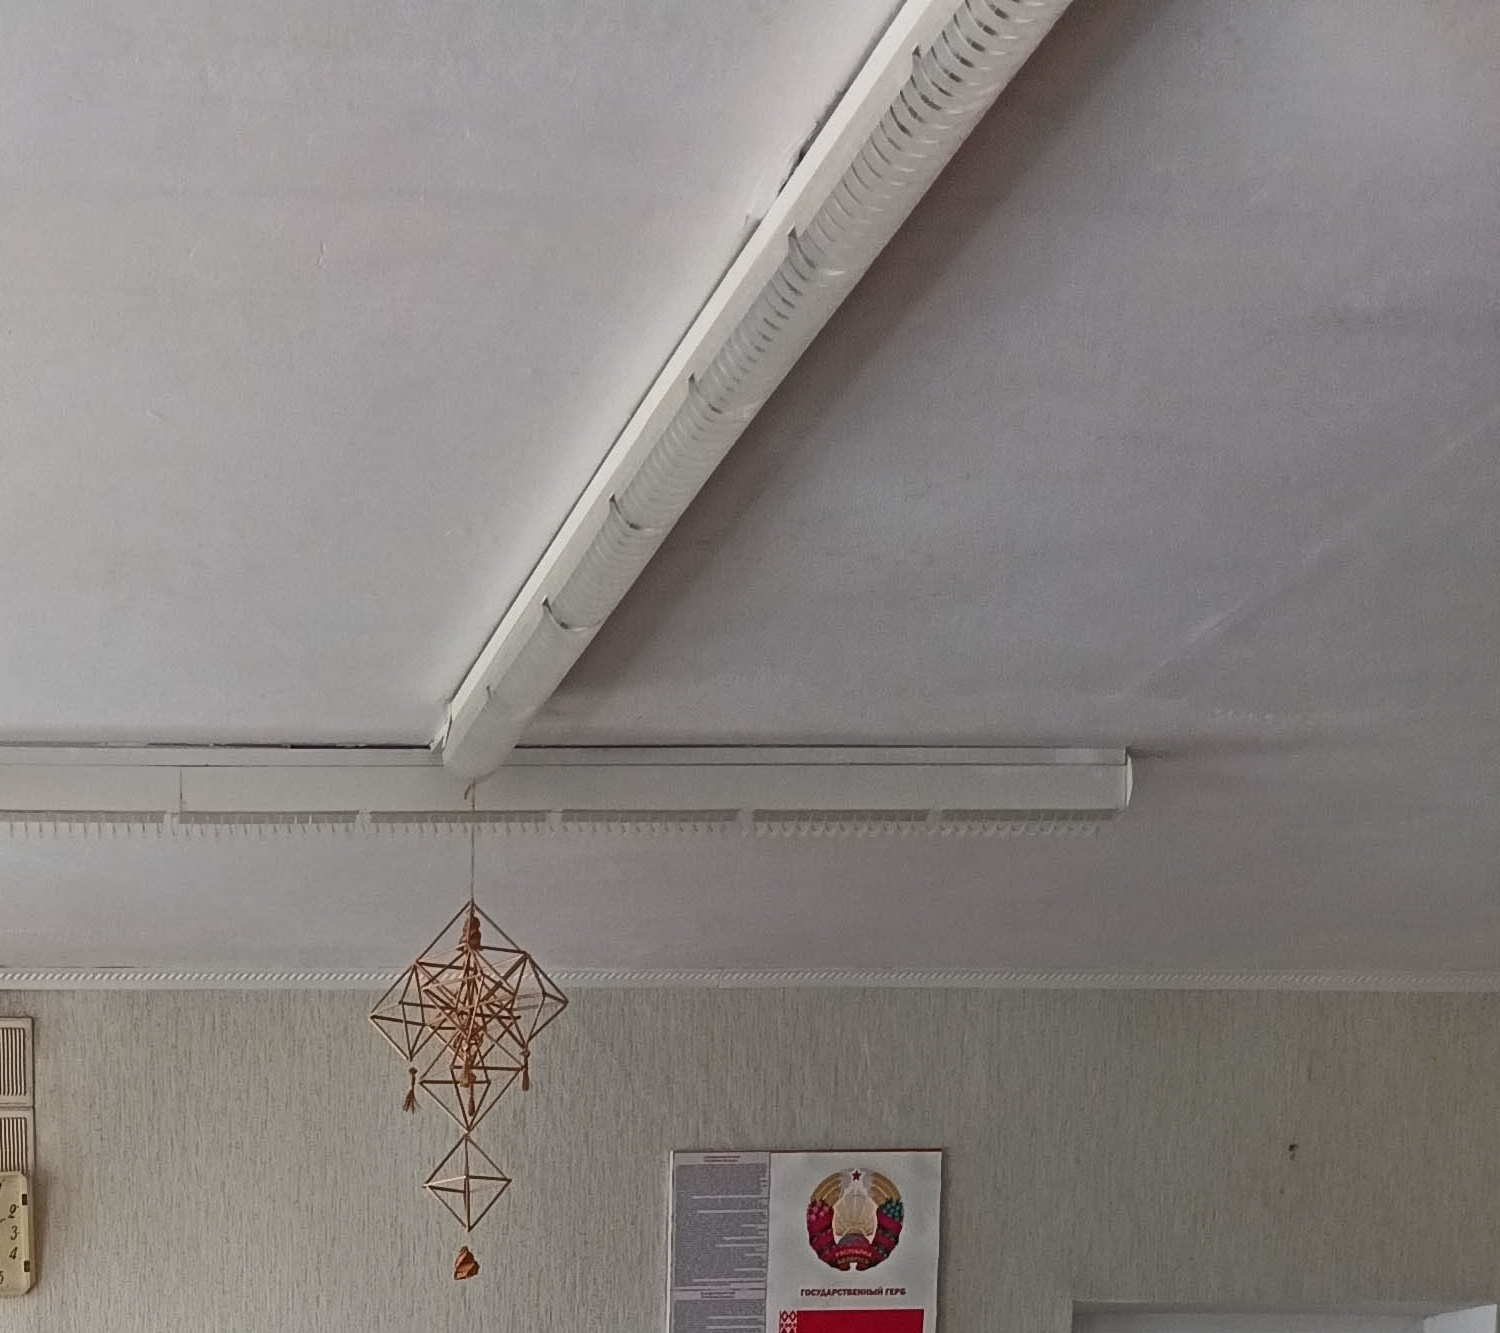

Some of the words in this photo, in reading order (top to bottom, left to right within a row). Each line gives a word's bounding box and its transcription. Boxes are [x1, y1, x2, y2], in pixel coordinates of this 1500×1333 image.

[8, 1204, 17, 1218] 2
[10, 1225, 18, 1240] 3
[8, 1246, 18, 1259] 4
[800, 1286, 884, 1297] ГОСУДАРСТВЕННЫЙ
[885, 1288, 906, 1296] ГЕРБ
